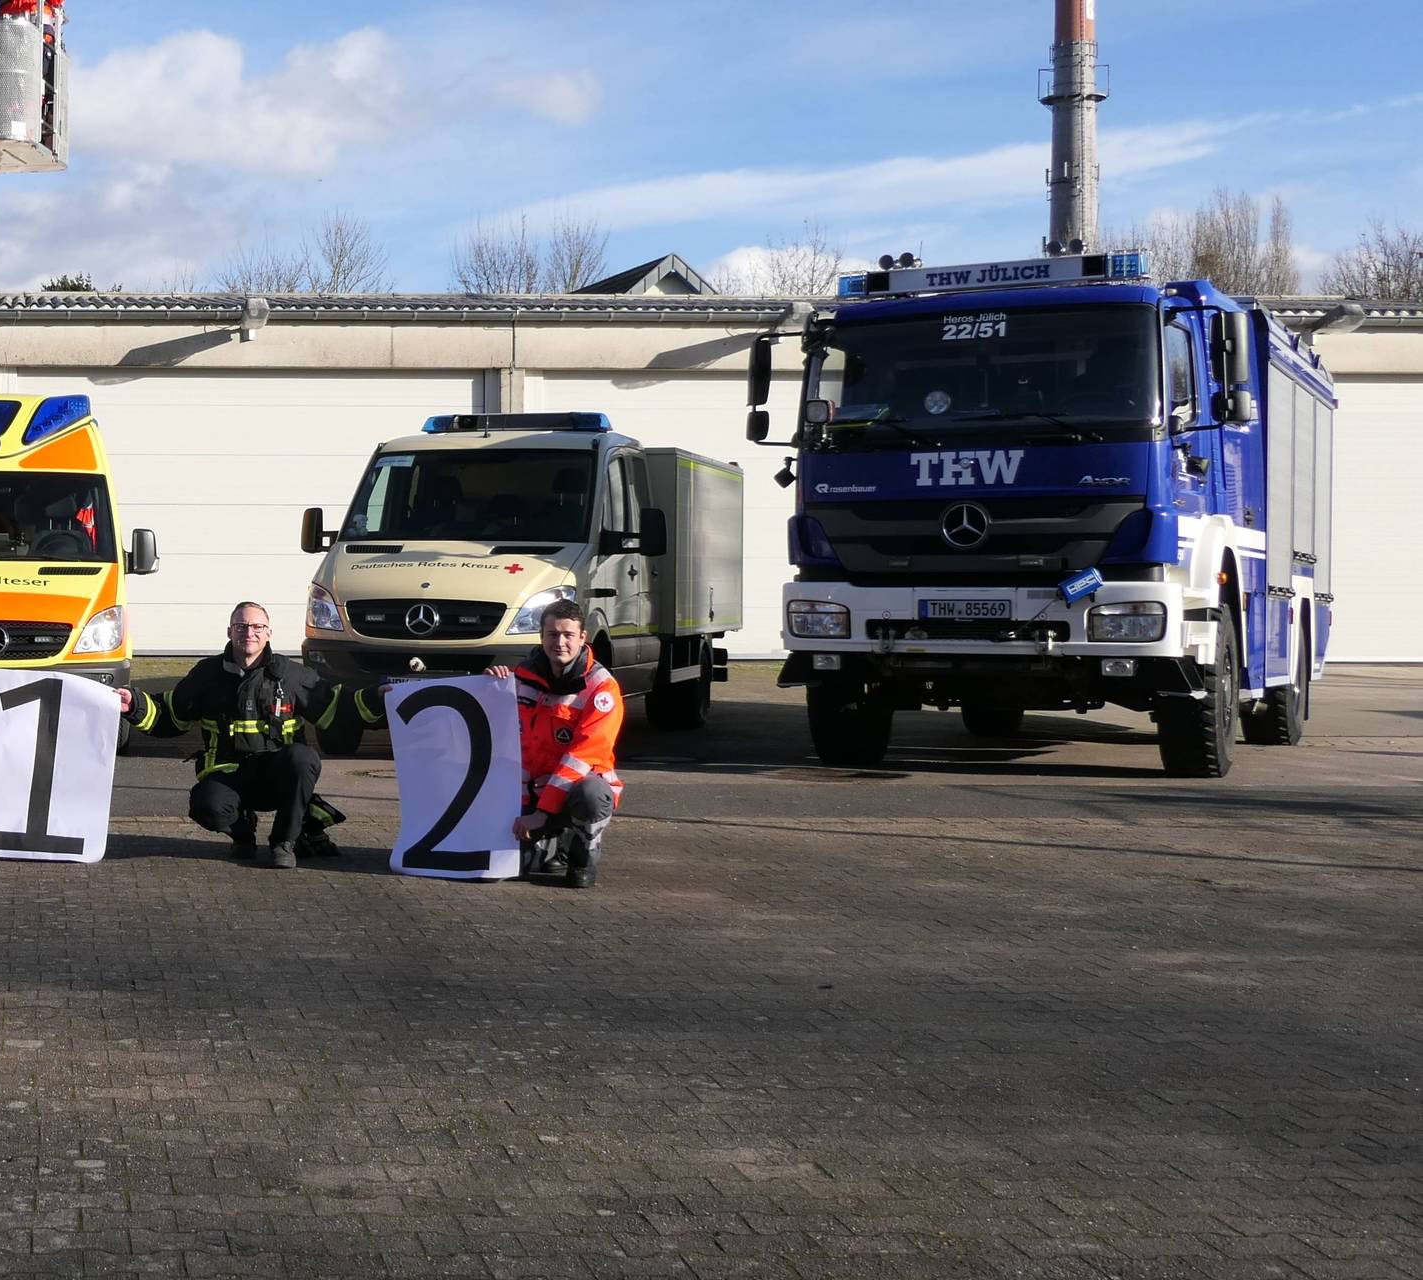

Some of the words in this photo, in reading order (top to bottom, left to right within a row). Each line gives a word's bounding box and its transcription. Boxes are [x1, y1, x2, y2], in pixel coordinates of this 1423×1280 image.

[926, 270, 972, 287] THW
[976, 265, 1051, 283] JÜLICH
[943, 315, 974, 324] Heros
[977, 312, 1007, 322] Jülich
[942, 321, 1007, 340] 22/51
[910, 450, 1025, 487] THW
[350, 562, 414, 571] Deutsches
[461, 562, 500, 570] Kreuz
[930, 602, 956, 617] THW
[965, 602, 1006, 617] 85569
[395, 685, 493, 871] 2
